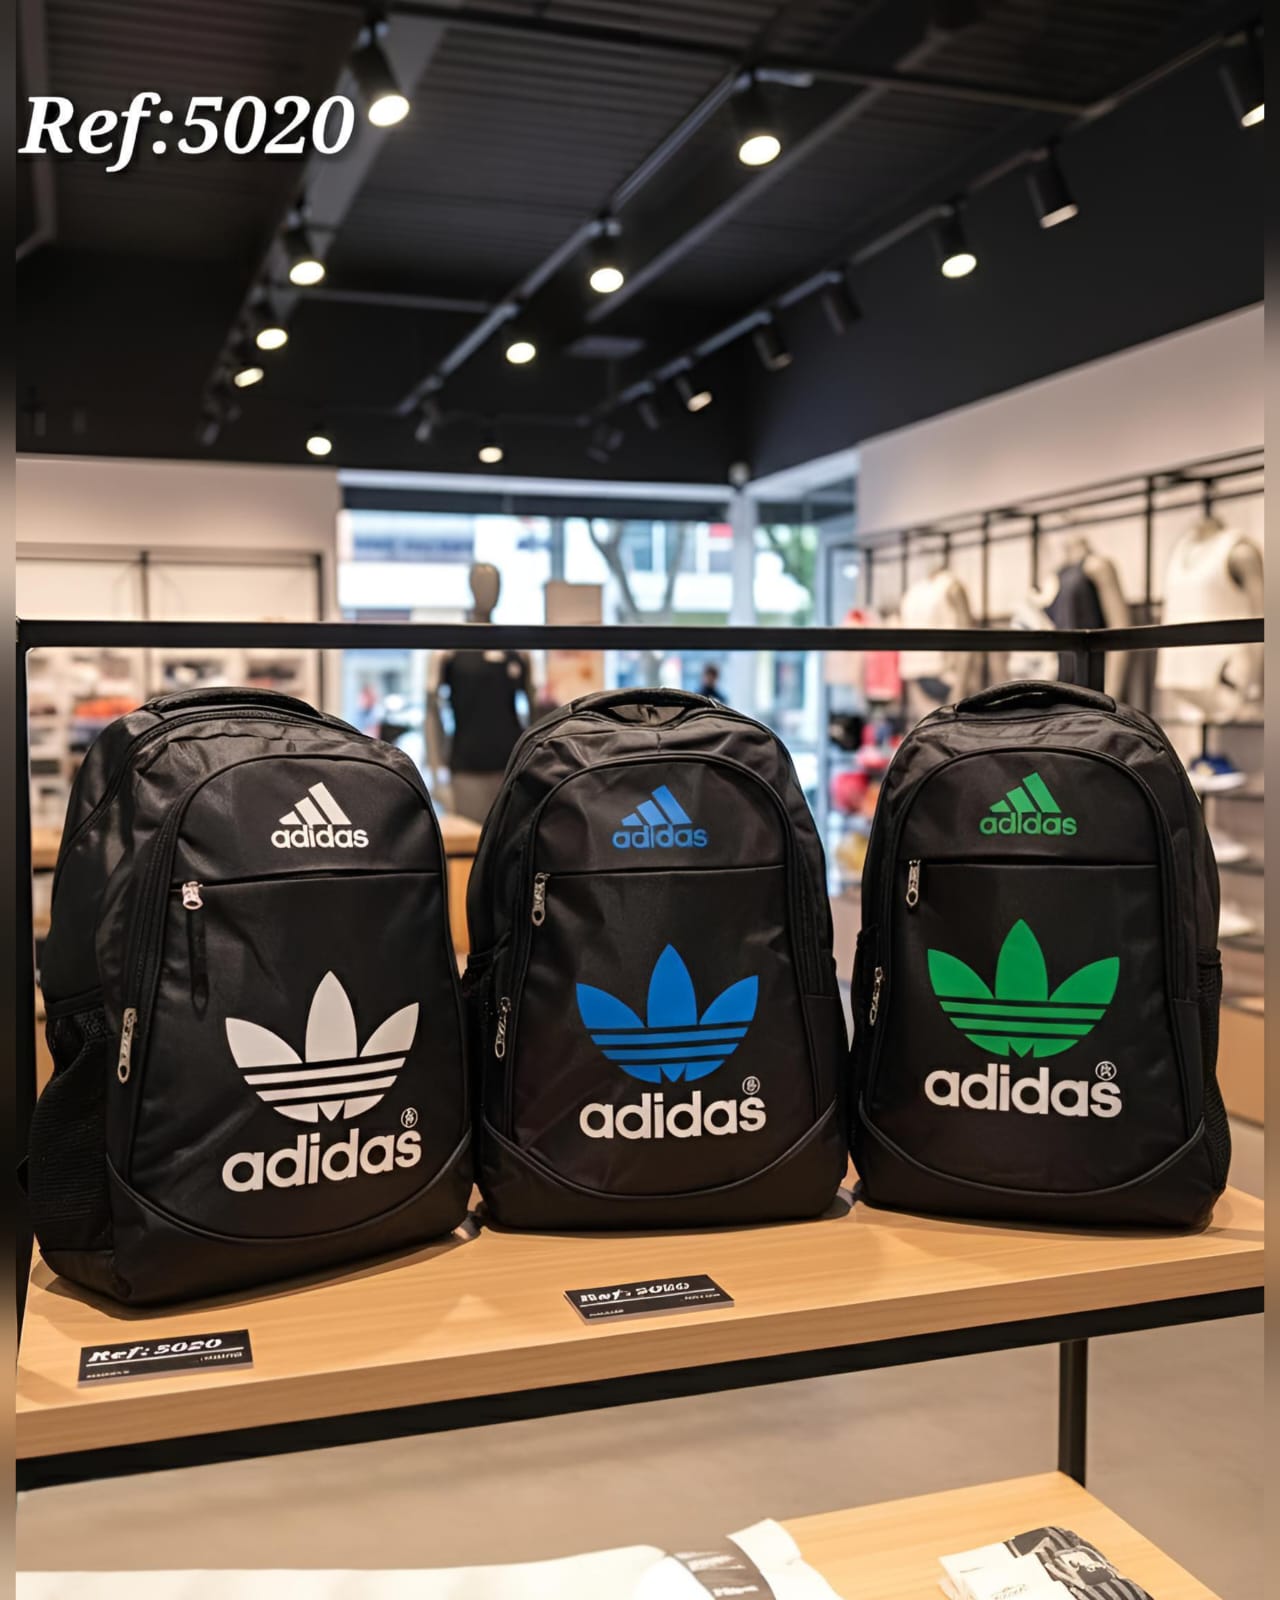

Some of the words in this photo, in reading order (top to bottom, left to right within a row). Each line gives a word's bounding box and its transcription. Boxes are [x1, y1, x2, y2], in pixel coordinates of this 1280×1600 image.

[271, 824, 369, 848] adidas
[612, 824, 708, 849] adidas
[980, 811, 1077, 835] adidas
[924, 1063, 1122, 1118] adidas
[579, 1090, 767, 1139] adidas
[222, 1128, 422, 1192] adidas
